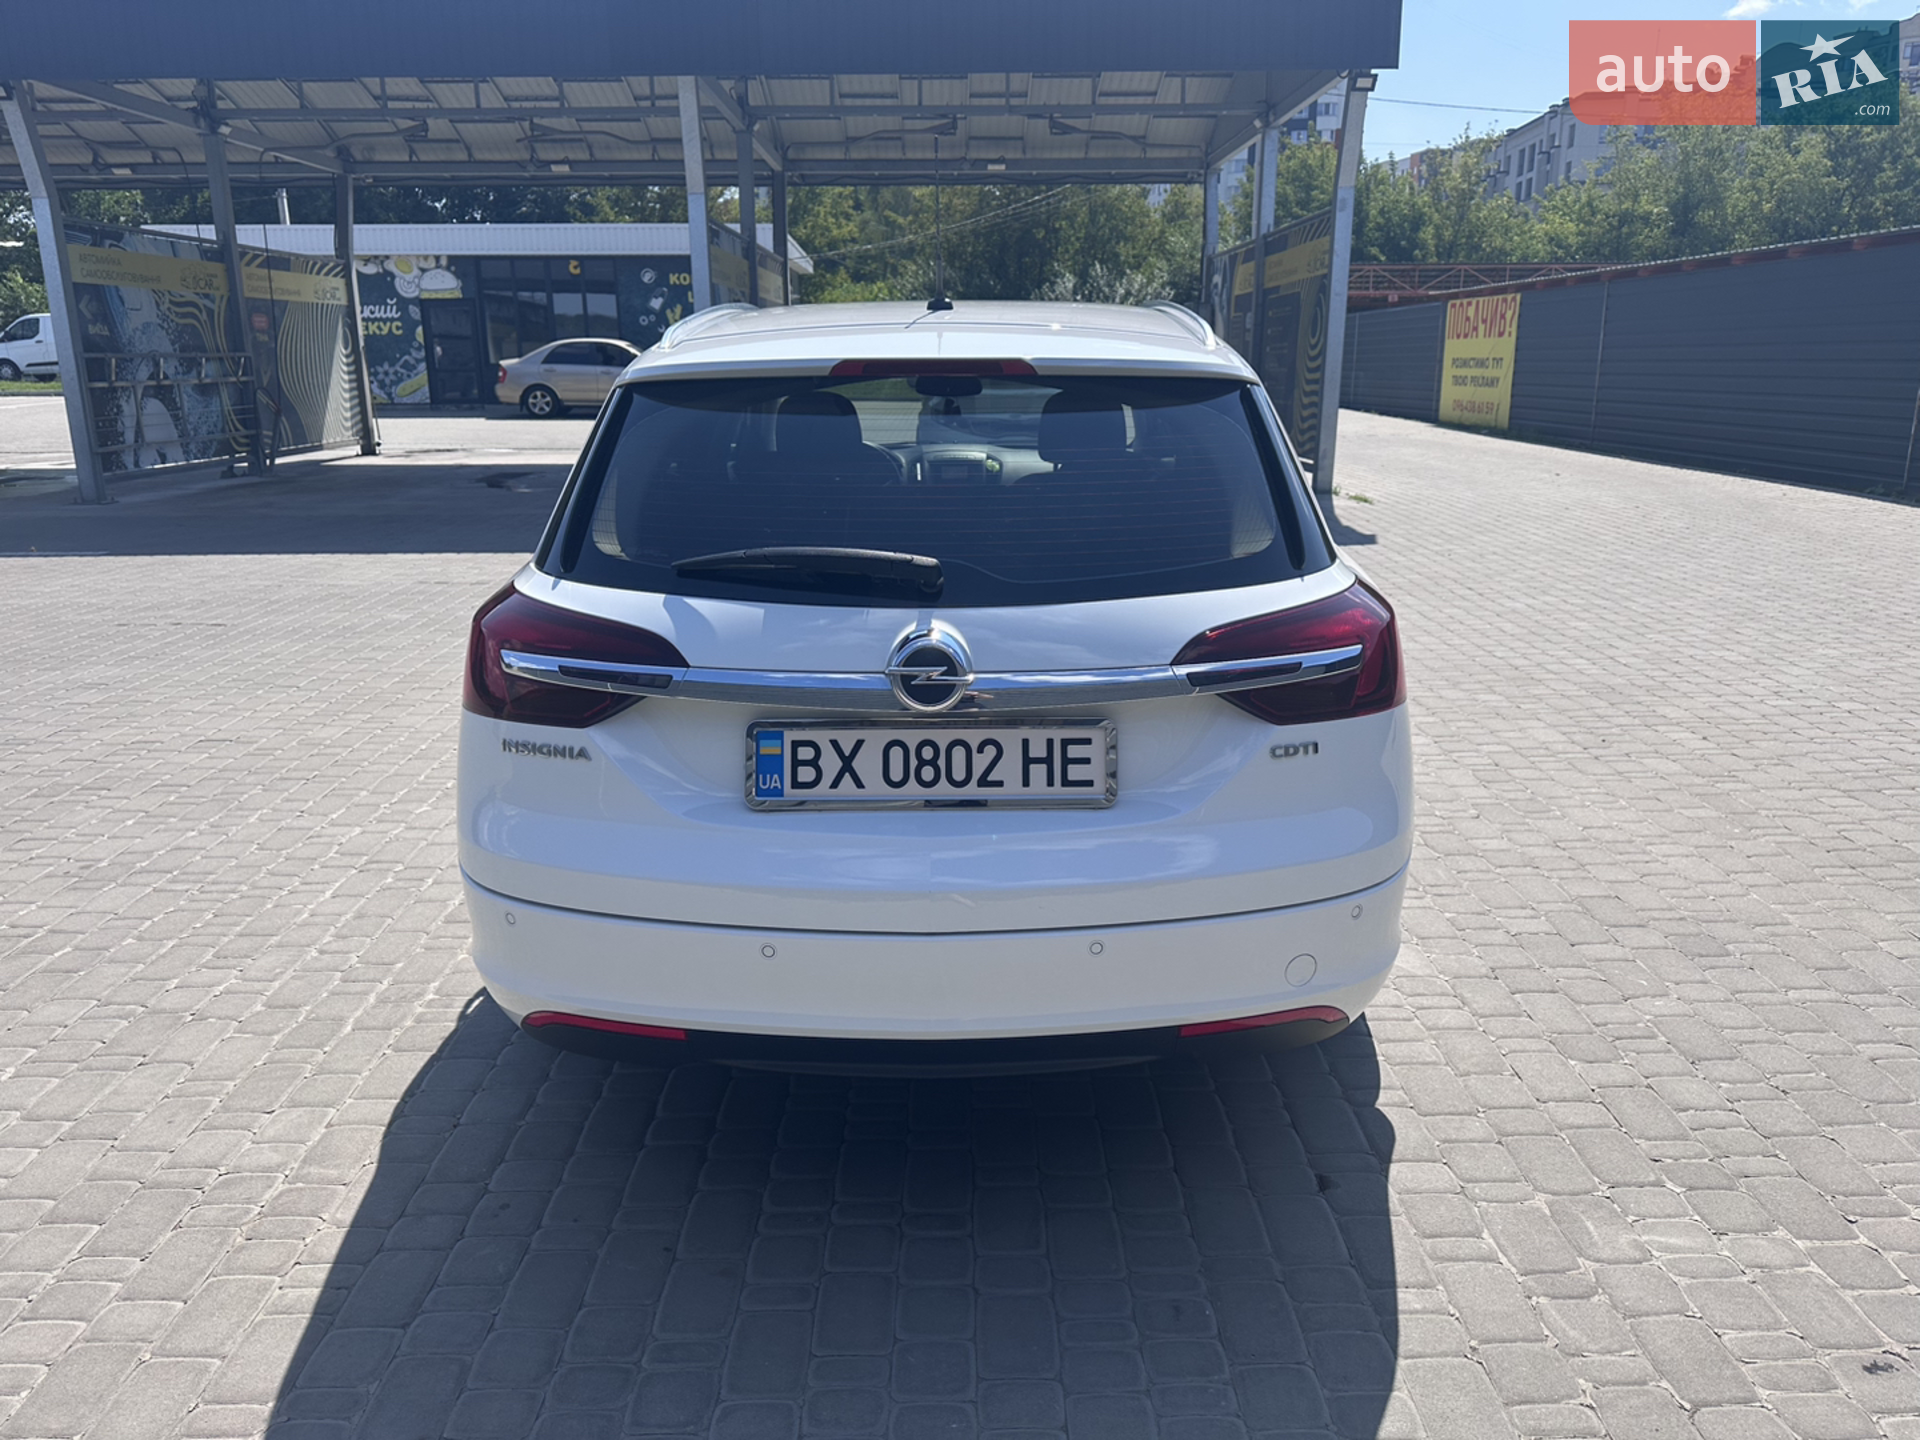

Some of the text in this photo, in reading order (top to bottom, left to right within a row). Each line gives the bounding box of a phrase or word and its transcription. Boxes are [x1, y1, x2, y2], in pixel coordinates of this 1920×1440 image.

[1447, 295, 1517, 340] ПОБАЧИВ?
[1491, 357, 1504, 369] ТУТ
[1451, 375, 1501, 388] ТВОЮ РЕКЛАМУ
[502, 738, 592, 761] INSIGNIA
[1269, 741, 1319, 760] CDTI
[790, 738, 1095, 790] BX 0802 HE
[758, 773, 782, 790] UA
